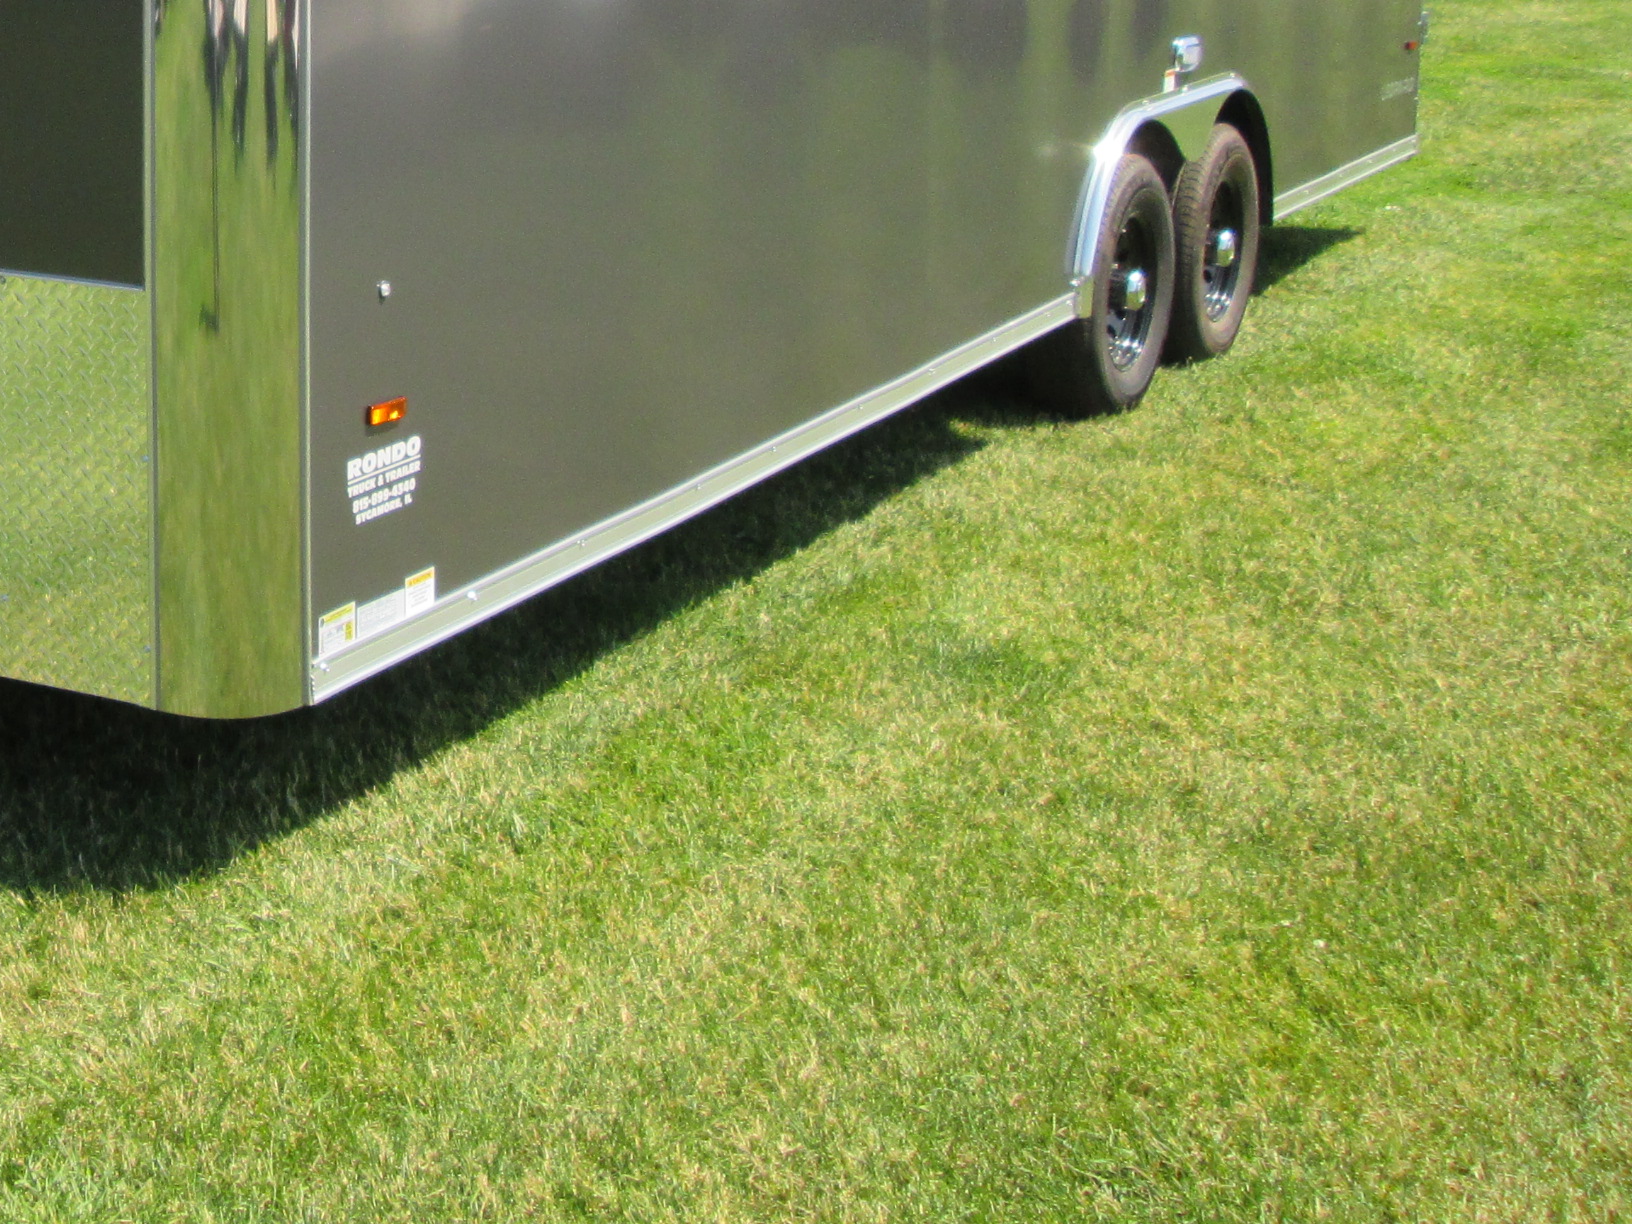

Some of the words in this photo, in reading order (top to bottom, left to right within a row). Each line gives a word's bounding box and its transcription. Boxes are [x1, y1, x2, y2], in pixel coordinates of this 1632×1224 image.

[347, 436, 421, 481] RONDO
[347, 477, 376, 498] TRUCK
[385, 460, 421, 484] TRAILER
